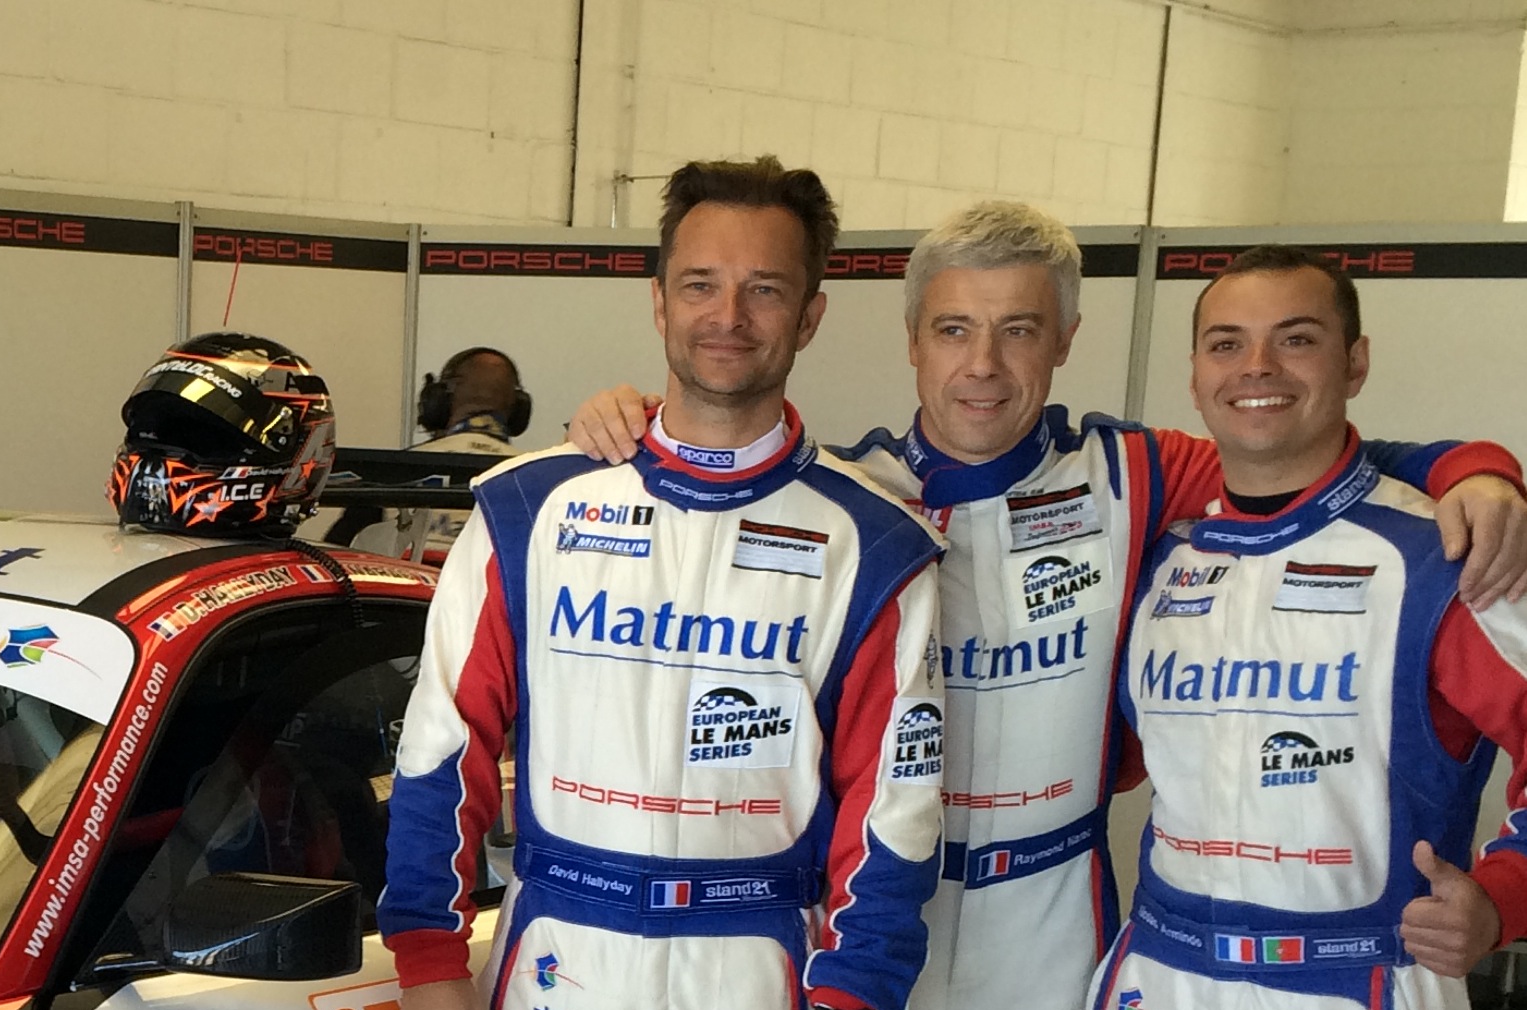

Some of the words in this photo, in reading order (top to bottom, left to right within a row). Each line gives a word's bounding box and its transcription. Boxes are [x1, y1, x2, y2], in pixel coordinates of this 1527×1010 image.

[193, 234, 334, 262] PORSCHE
[425, 249, 646, 272] PORSCHE
[677, 446, 732, 464] sparco
[659, 479, 753, 501] PORSCHE
[566, 502, 628, 525] Mobil
[1011, 502, 1084, 525] MOTORSPORT
[576, 535, 649, 554] MICHELIN
[738, 535, 818, 553] MOTORSPORT
[1203, 522, 1299, 545] PORSCHE
[1023, 560, 1091, 594] EUROPEAN
[1166, 566, 1211, 588] Mobil
[1282, 577, 1364, 589] MOTORSPORT
[179, 565, 297, 623] D.HALLYDAY
[1025, 592, 1046, 610] LE
[1052, 569, 1102, 601] MANS
[1028, 596, 1076, 623] SERIES
[550, 585, 809, 664] Matmut
[1140, 648, 1360, 702] Matmut
[692, 706, 782, 727] EUROPEAN
[691, 727, 715, 744] LE
[724, 717, 792, 742] MANS
[897, 724, 943, 744] EUROPE
[689, 742, 753, 762] SERIES
[895, 746, 917, 763] LE
[923, 739, 943, 761] MA
[1260, 754, 1283, 771] LE
[1290, 746, 1355, 770] MANS
[892, 761, 942, 779] SERIES
[1260, 769, 1318, 788] SERIES
[552, 776, 782, 816] PORSCHE
[24, 660, 169, 959] www.imsa-performance.com
[548, 864, 578, 882] David
[582, 872, 633, 895] Hallyday
[705, 880, 771, 898] stand21
